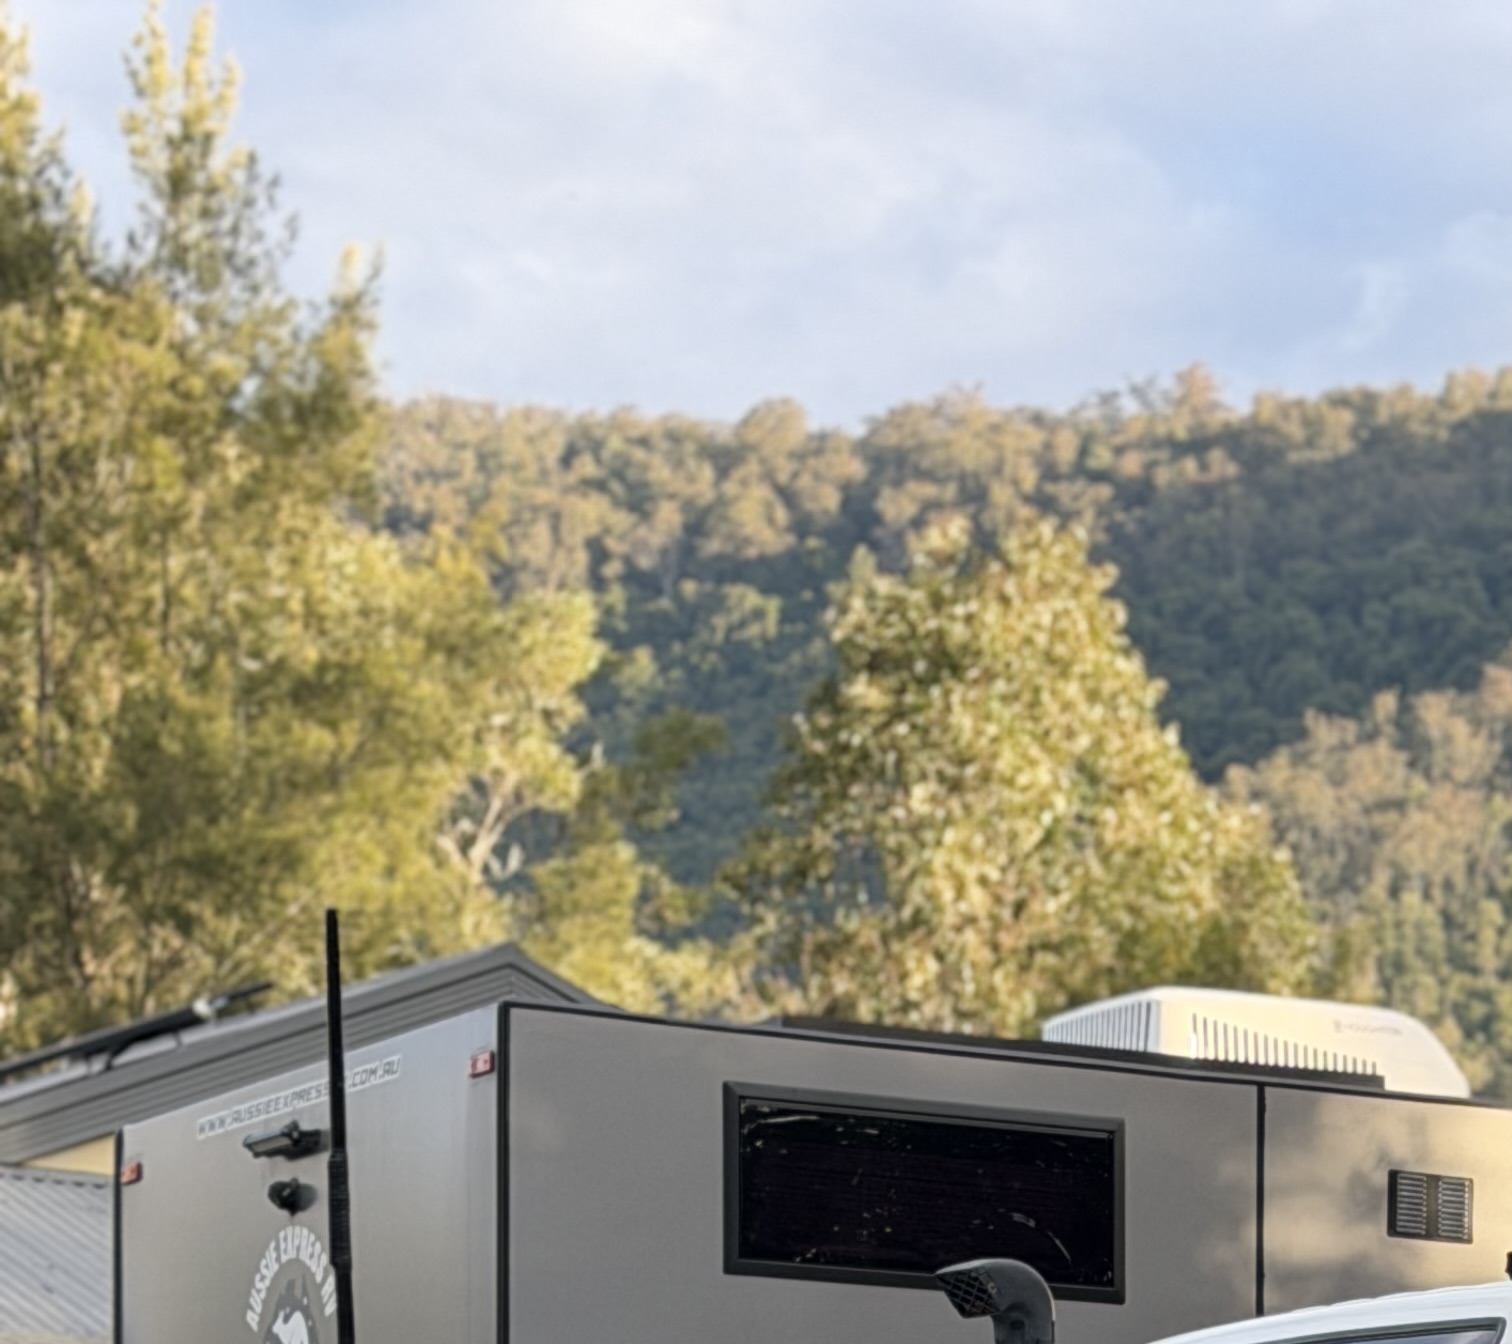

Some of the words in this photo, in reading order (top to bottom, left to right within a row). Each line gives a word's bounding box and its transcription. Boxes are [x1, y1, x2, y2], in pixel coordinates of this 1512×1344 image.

[197, 1055, 401, 1139] WWW.AUSSIEEXPRESS.COM.AU
[245, 1239, 280, 1333] AUSSIE
[278, 1225, 328, 1284] EXPRESS
